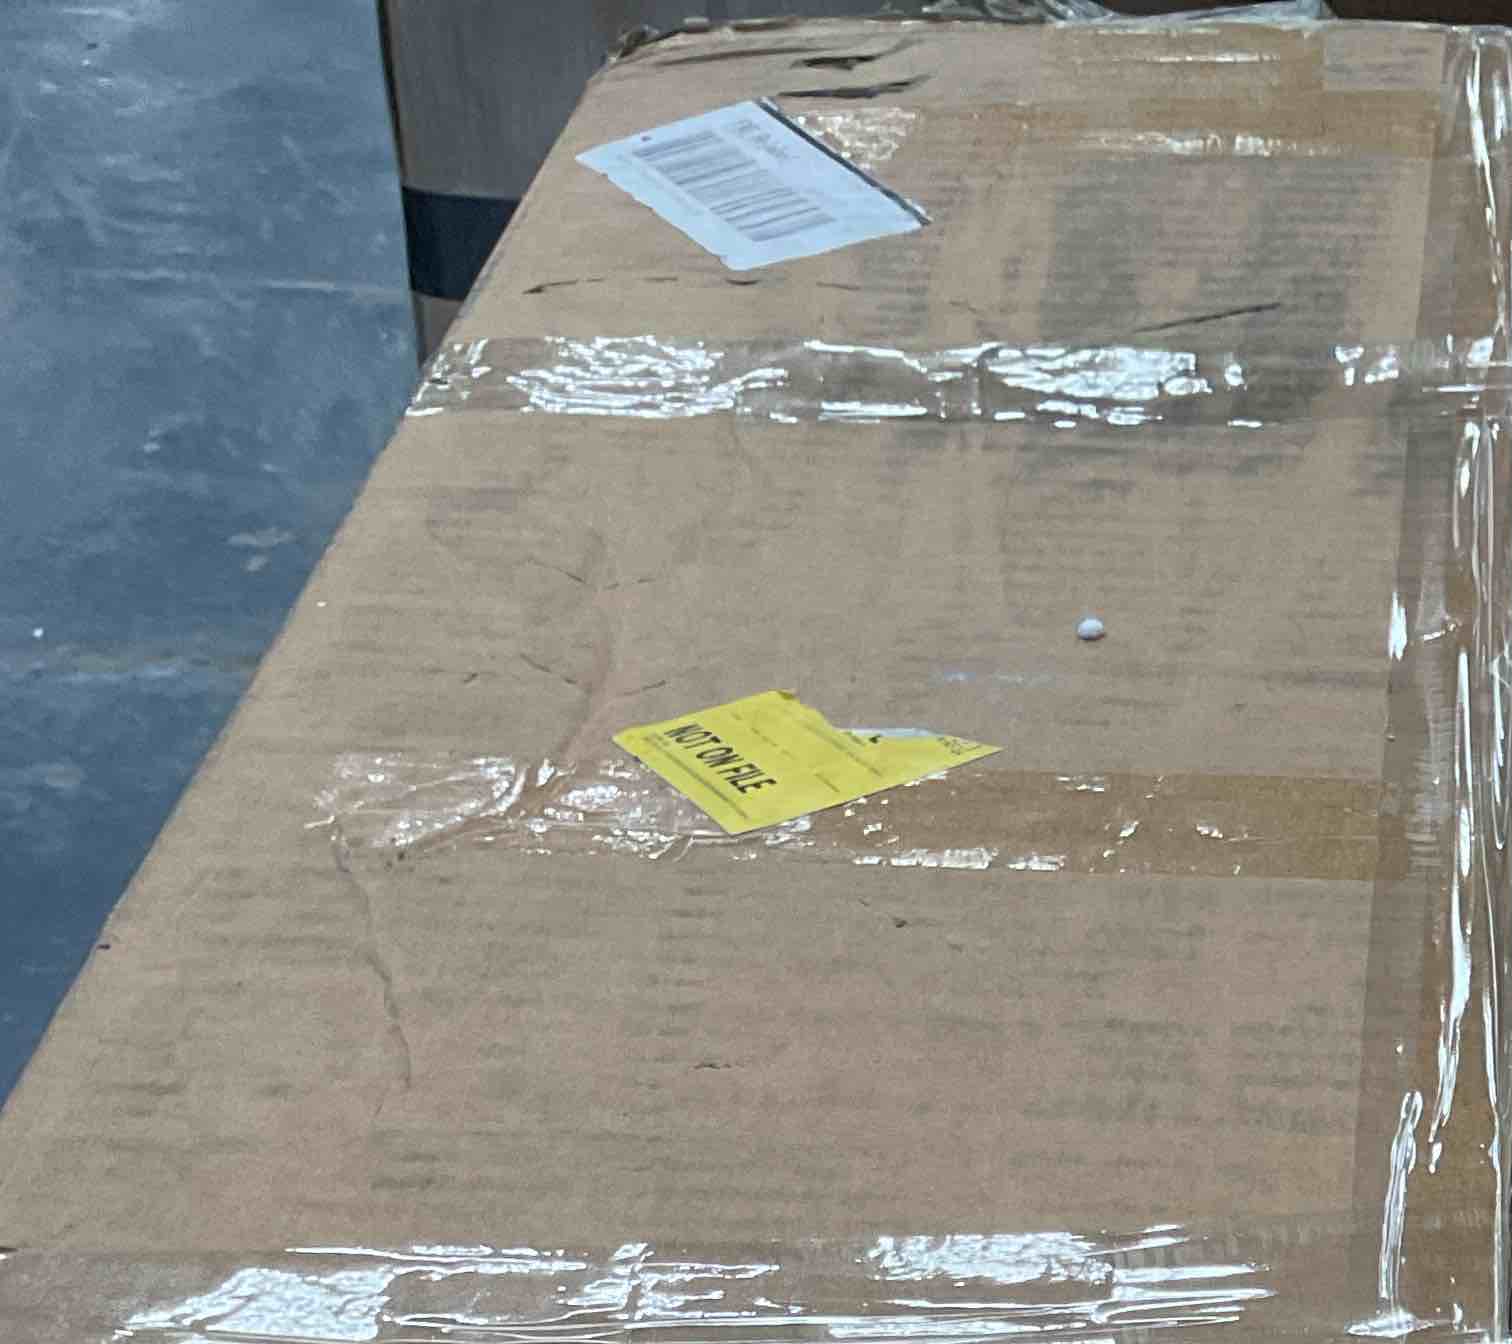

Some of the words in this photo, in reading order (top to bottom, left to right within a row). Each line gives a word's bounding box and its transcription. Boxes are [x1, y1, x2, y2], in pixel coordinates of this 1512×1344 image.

[664, 723, 722, 749] NOT
[696, 747, 744, 768] ON
[716, 763, 777, 793] FILE
